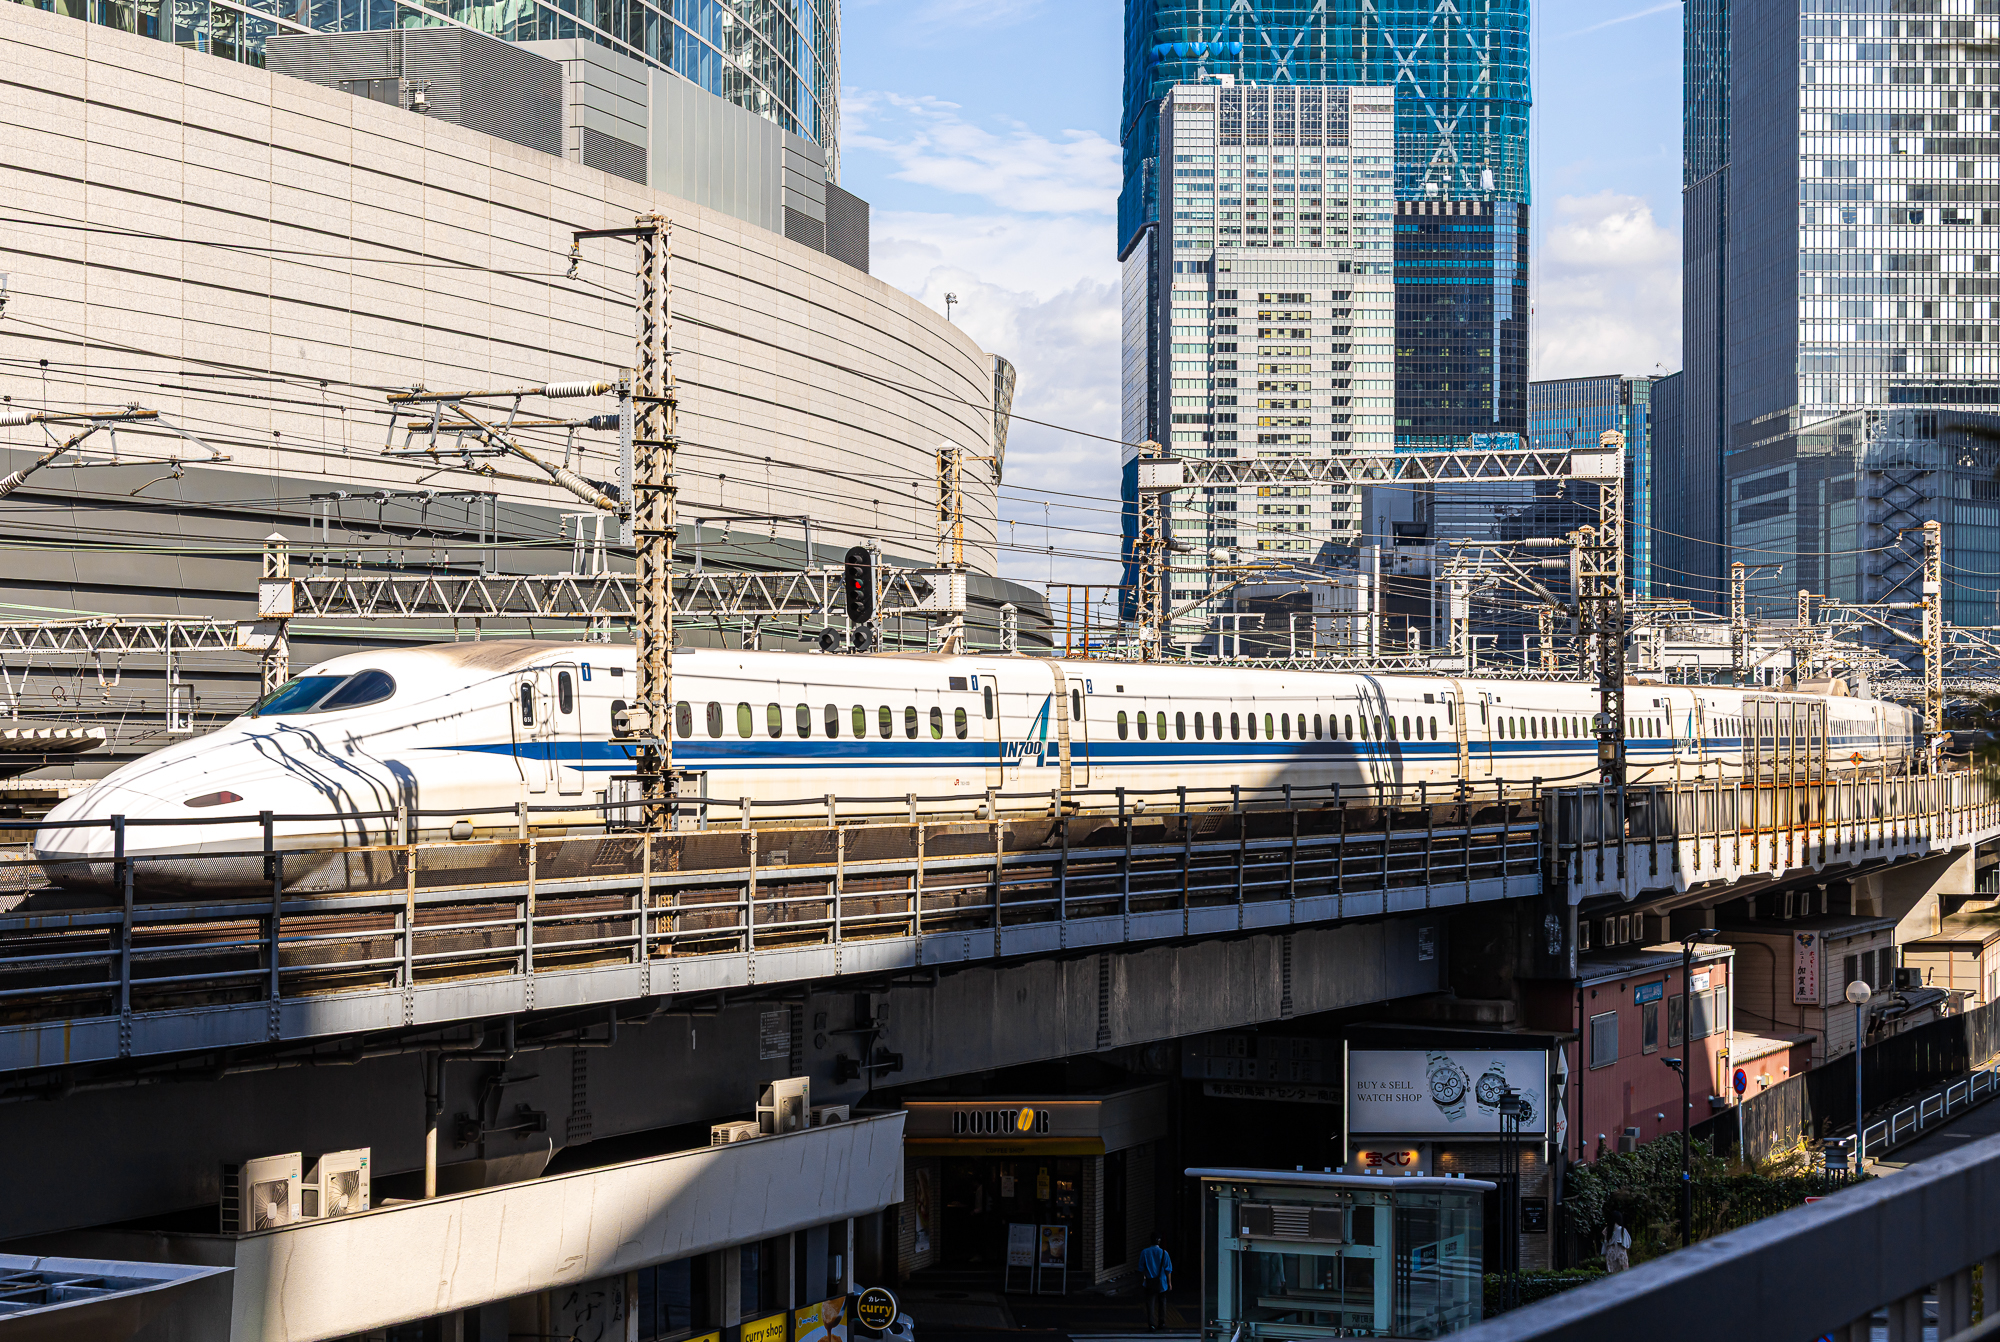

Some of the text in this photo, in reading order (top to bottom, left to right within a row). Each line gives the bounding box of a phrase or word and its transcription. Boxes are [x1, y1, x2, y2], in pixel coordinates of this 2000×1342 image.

[583, 664, 589, 680] 1
[972, 676, 977, 690] 1
[1086, 680, 1092, 693] 2
[1007, 741, 1043, 758] N700
[1357, 1081, 1414, 1090] BUY & SELL
[1357, 1093, 1423, 1102] WATCH SHOP
[952, 1106, 1050, 1135] DOUTOR
[1365, 1151, 1411, 1167] 宝くじ
[868, 1295, 887, 1303] カレー
[860, 1304, 892, 1318] curry
[745, 1323, 783, 1342] curry shop
